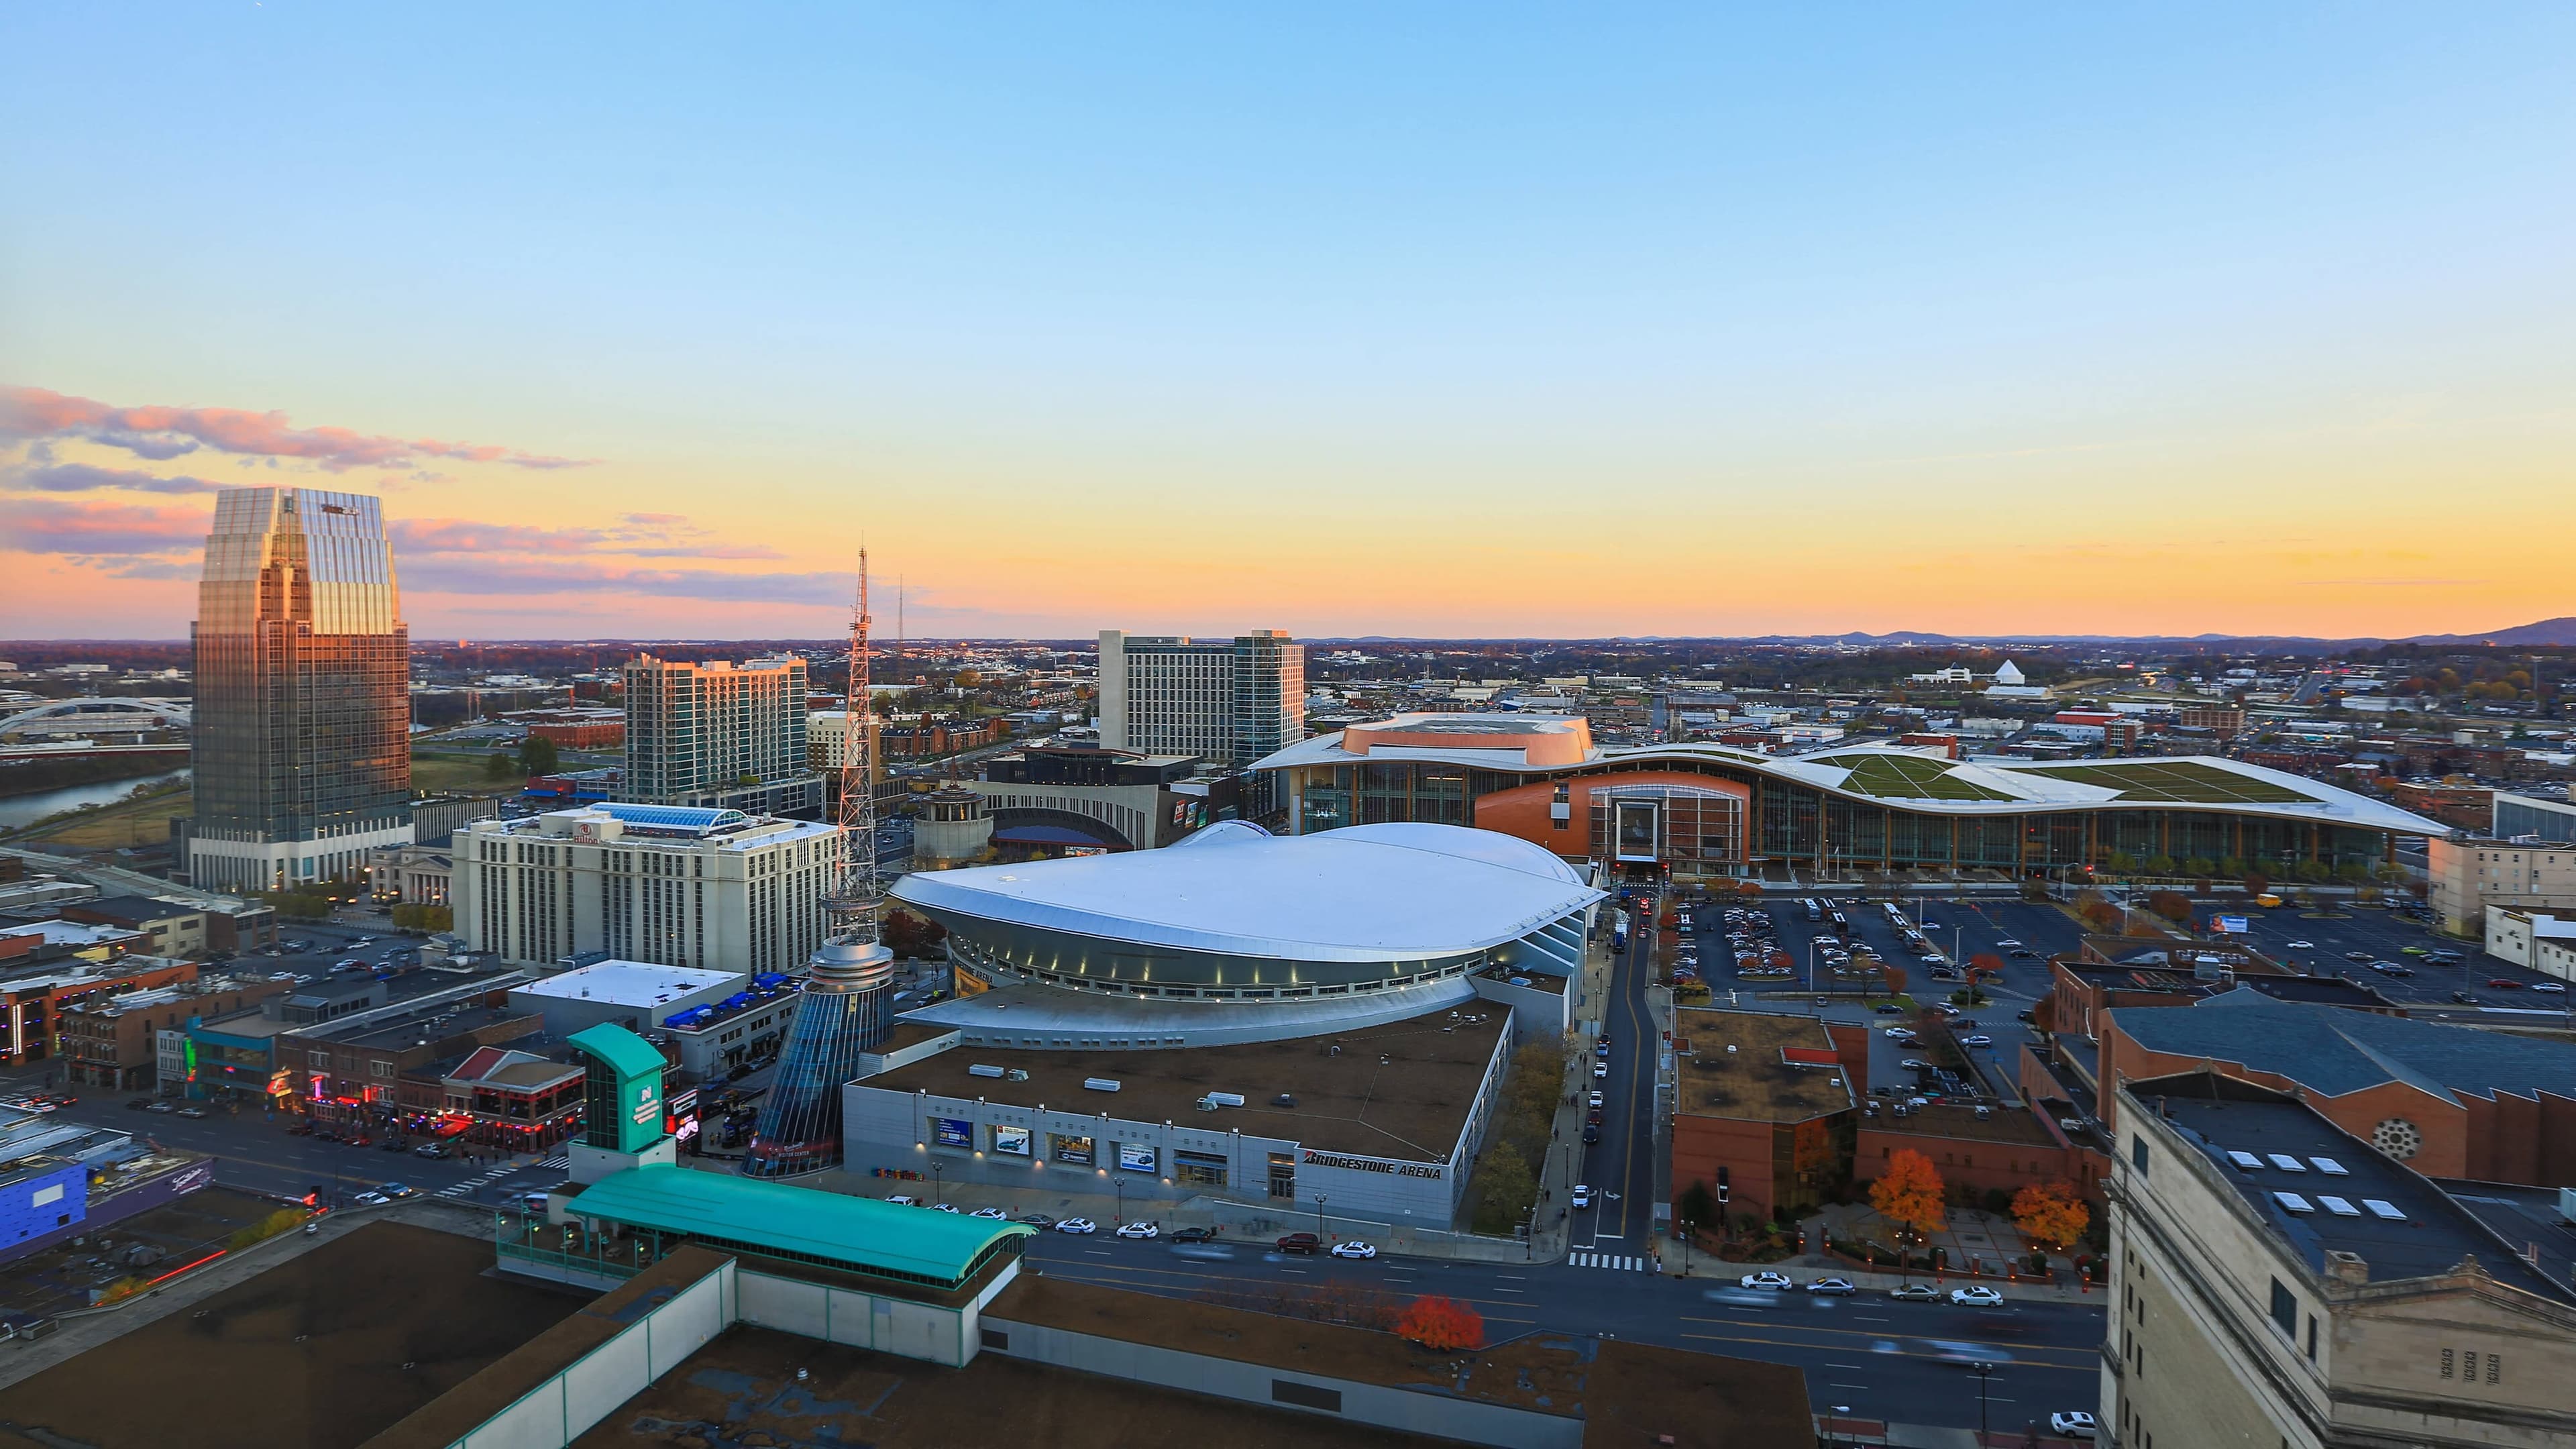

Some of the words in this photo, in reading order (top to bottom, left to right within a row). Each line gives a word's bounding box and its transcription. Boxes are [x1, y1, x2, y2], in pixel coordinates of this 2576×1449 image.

[574, 835, 599, 844] Hilton
[1303, 1151, 1395, 1173] BRIDGESTONE
[1398, 1165, 1441, 1179] ARENA
